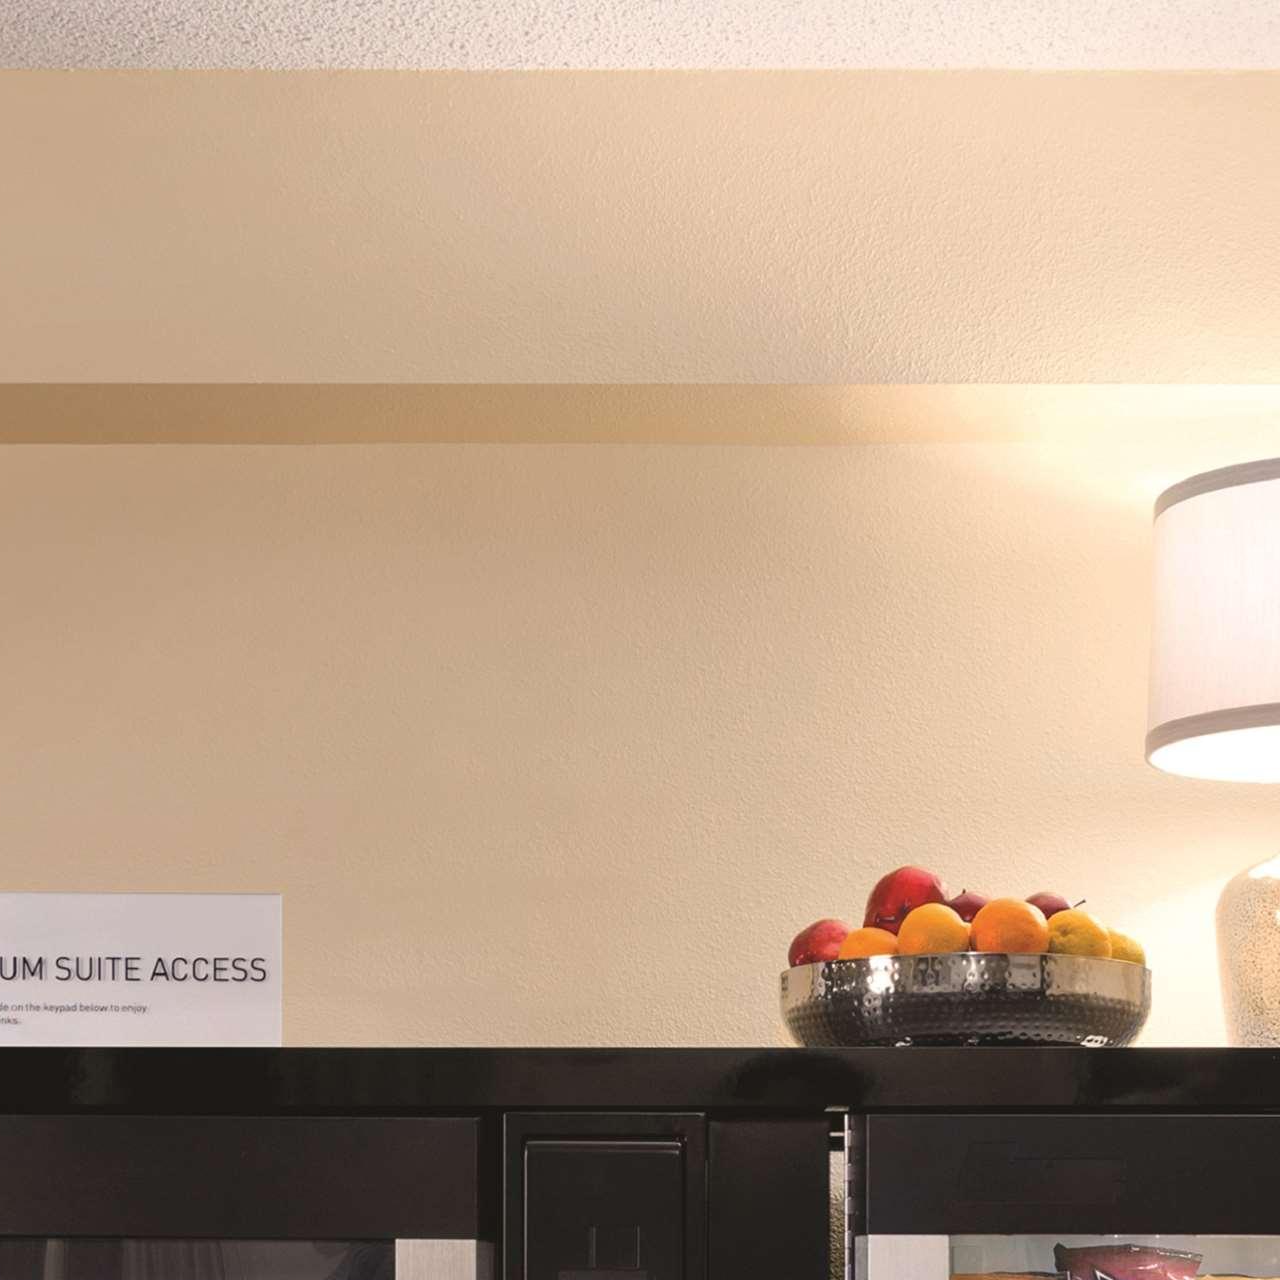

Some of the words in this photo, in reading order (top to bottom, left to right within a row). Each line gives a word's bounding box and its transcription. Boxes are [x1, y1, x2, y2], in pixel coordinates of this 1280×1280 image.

[55, 956, 141, 982] SUITE
[150, 957, 268, 983] ACCESS
[13, 1004, 24, 1012] on
[25, 1002, 41, 1012] the
[43, 1002, 77, 1014] keypad
[79, 1002, 108, 1012] below
[110, 1003, 119, 1012] to
[121, 1003, 147, 1014] enjoy
